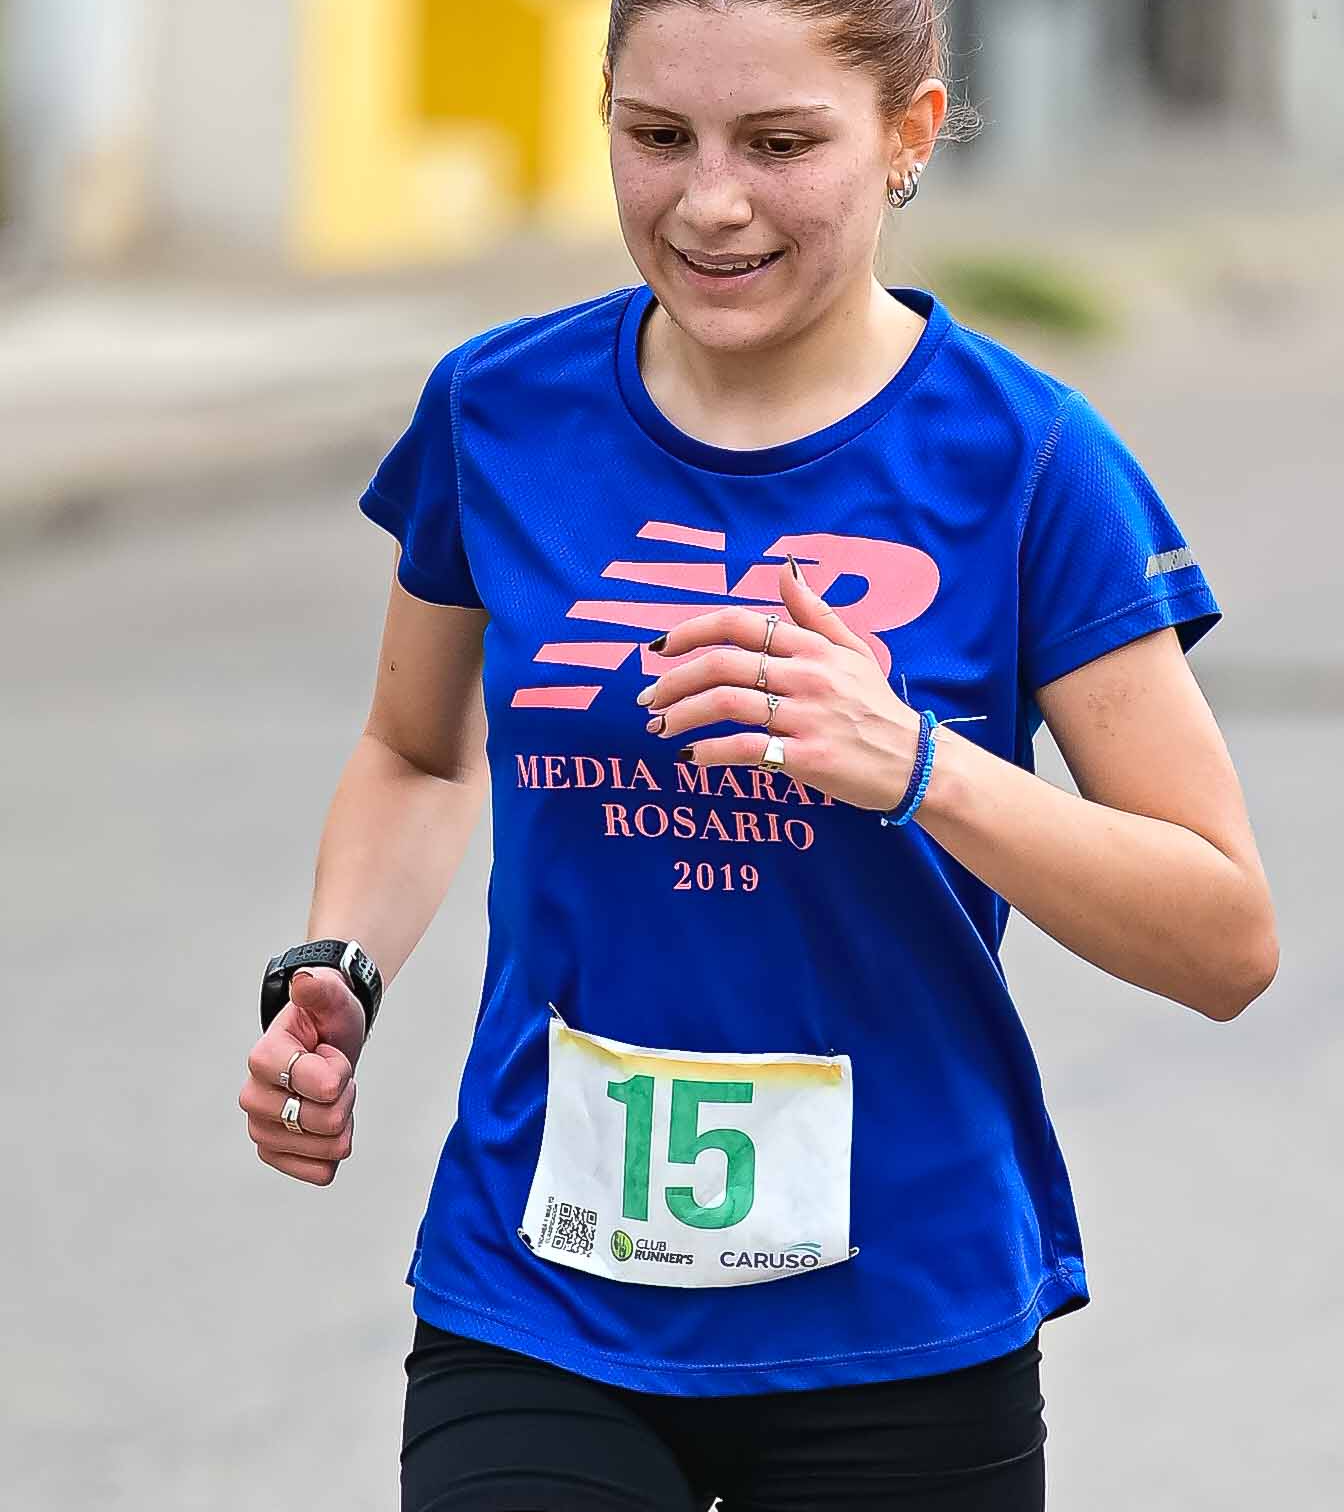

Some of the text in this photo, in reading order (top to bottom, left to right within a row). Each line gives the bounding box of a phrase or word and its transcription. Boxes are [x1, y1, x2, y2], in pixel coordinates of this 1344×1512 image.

[515, 754, 836, 807] MEDIA MARA
[602, 803, 815, 851] ROSARIO
[673, 861, 760, 892] 2019
[606, 1074, 757, 1230] 15
[634, 1249, 694, 1265] RUNNER'S
[636, 1238, 667, 1251] CLUB
[720, 1251, 819, 1269] CARUSO
